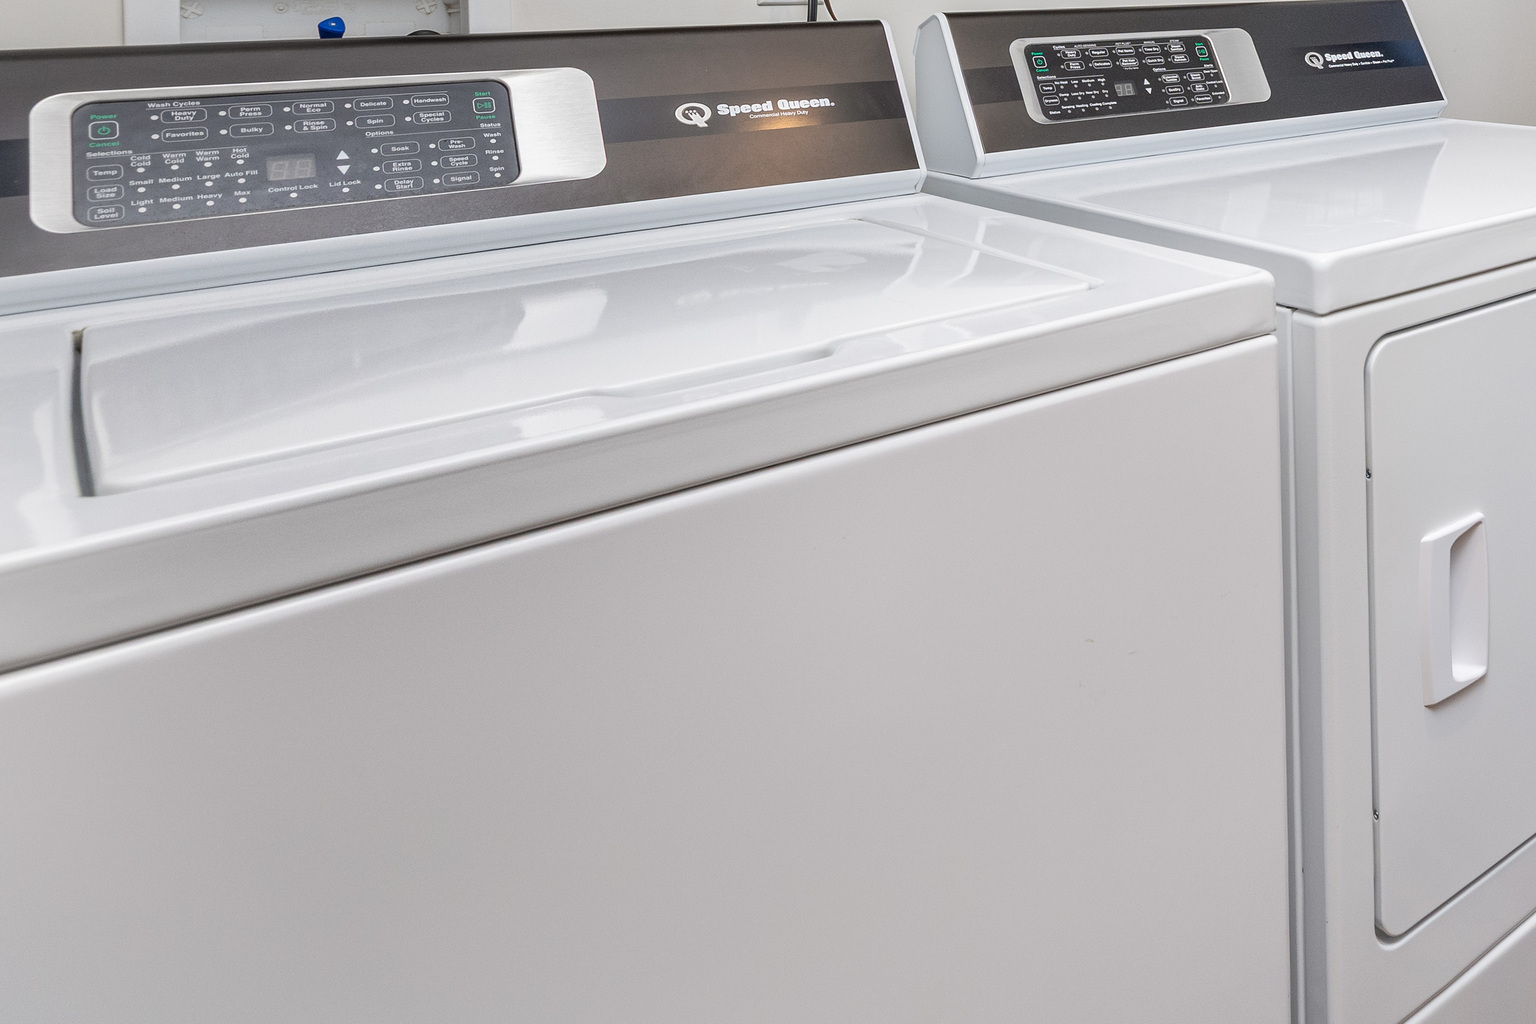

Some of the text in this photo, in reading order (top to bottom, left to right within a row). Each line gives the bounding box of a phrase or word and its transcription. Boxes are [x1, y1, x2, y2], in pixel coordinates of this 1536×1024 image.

[1324, 51, 1354, 63] Speed
[413, 96, 447, 104] Handwash
[717, 100, 774, 117] Speed
[749, 111, 780, 119] Commercial
[240, 126, 264, 134] Bulky
[86, 149, 133, 157] Selections
[197, 173, 221, 181] Large
[268, 183, 319, 193] Control Lock
[159, 195, 194, 203] Medium
[197, 192, 223, 200] Heavy
